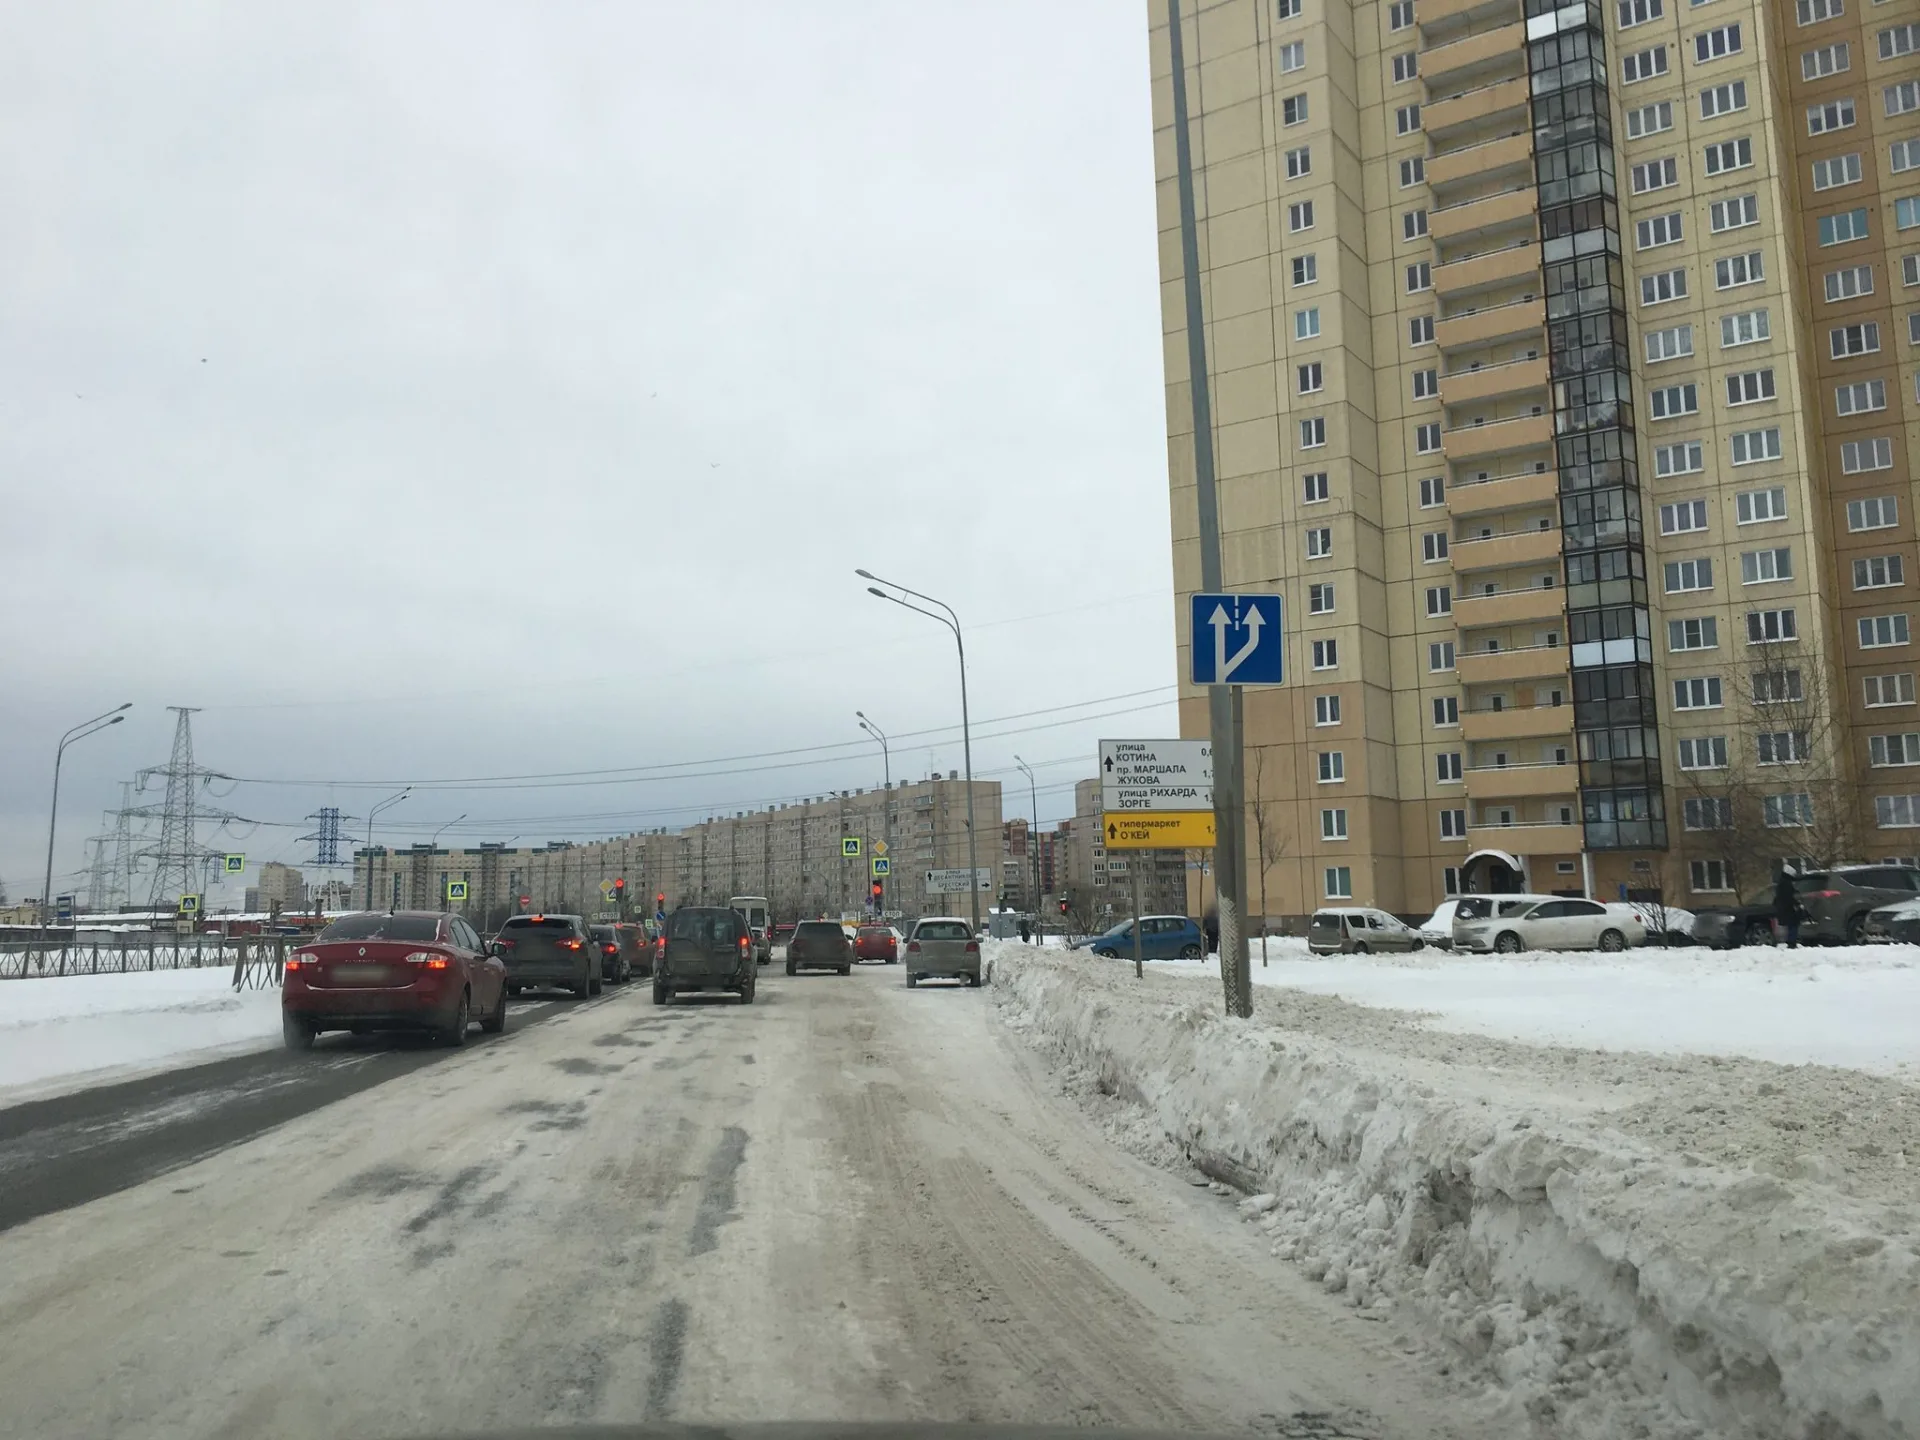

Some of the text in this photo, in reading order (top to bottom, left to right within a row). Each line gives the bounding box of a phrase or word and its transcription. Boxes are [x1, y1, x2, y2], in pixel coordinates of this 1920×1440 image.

[1116, 744, 1145, 752] улица
[1116, 754, 1157, 762] КОТИНА
[1117, 765, 1186, 775] пр. МАРШАЛА
[1117, 776, 1160, 784] ЖУКОВА
[1118, 788, 1197, 798] улица РИХАРДА
[1204, 794, 1215, 803] 1,
[1119, 799, 1151, 808] ЗОРГЕ
[1120, 819, 1181, 829] гипермаркет
[1207, 825, 1217, 835] 1,
